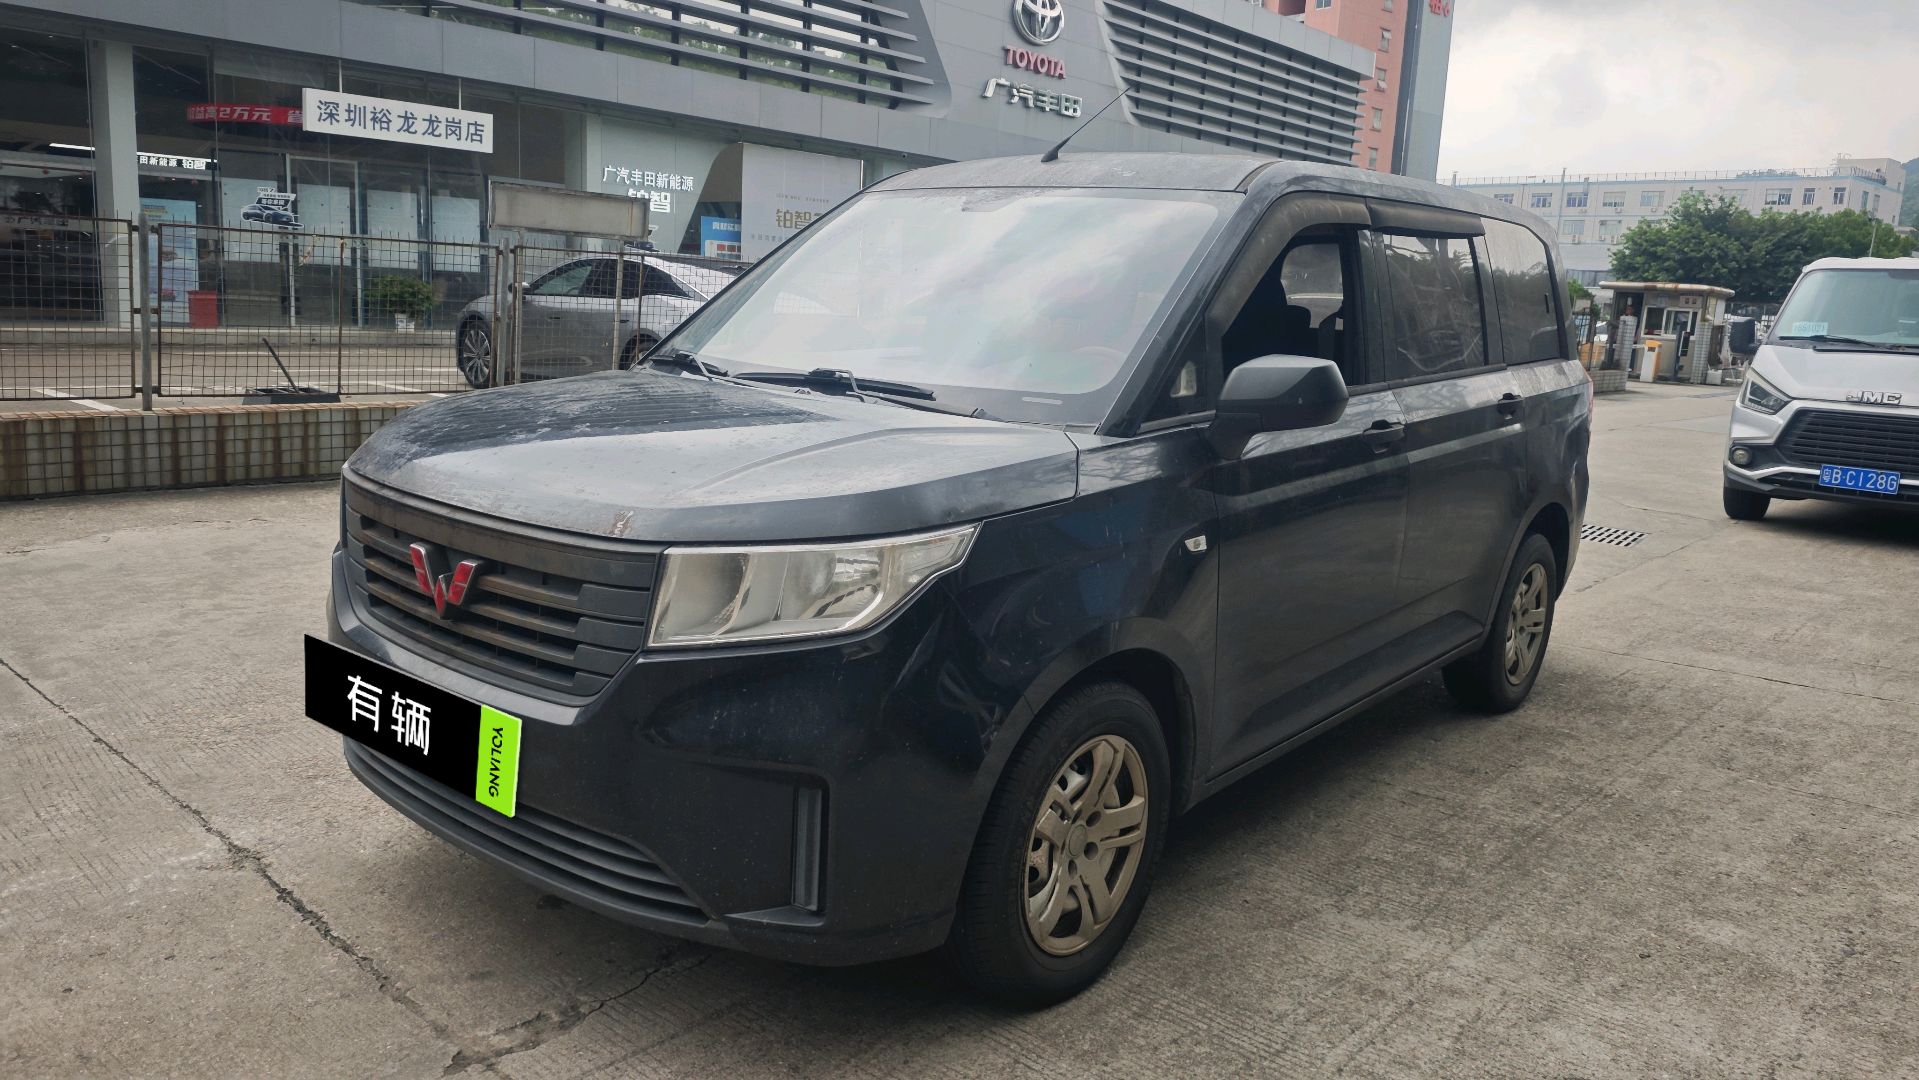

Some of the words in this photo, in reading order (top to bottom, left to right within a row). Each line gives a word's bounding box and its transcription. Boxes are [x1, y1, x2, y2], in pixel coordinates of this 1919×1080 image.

[1005, 44, 1066, 80] TOYOTA
[982, 77, 1083, 118] 广汽丰田
[316, 99, 485, 145] 深圳裕龙龙岗店
[602, 164, 694, 192] 广汽丰田新能源
[1846, 390, 1902, 405] JMC
